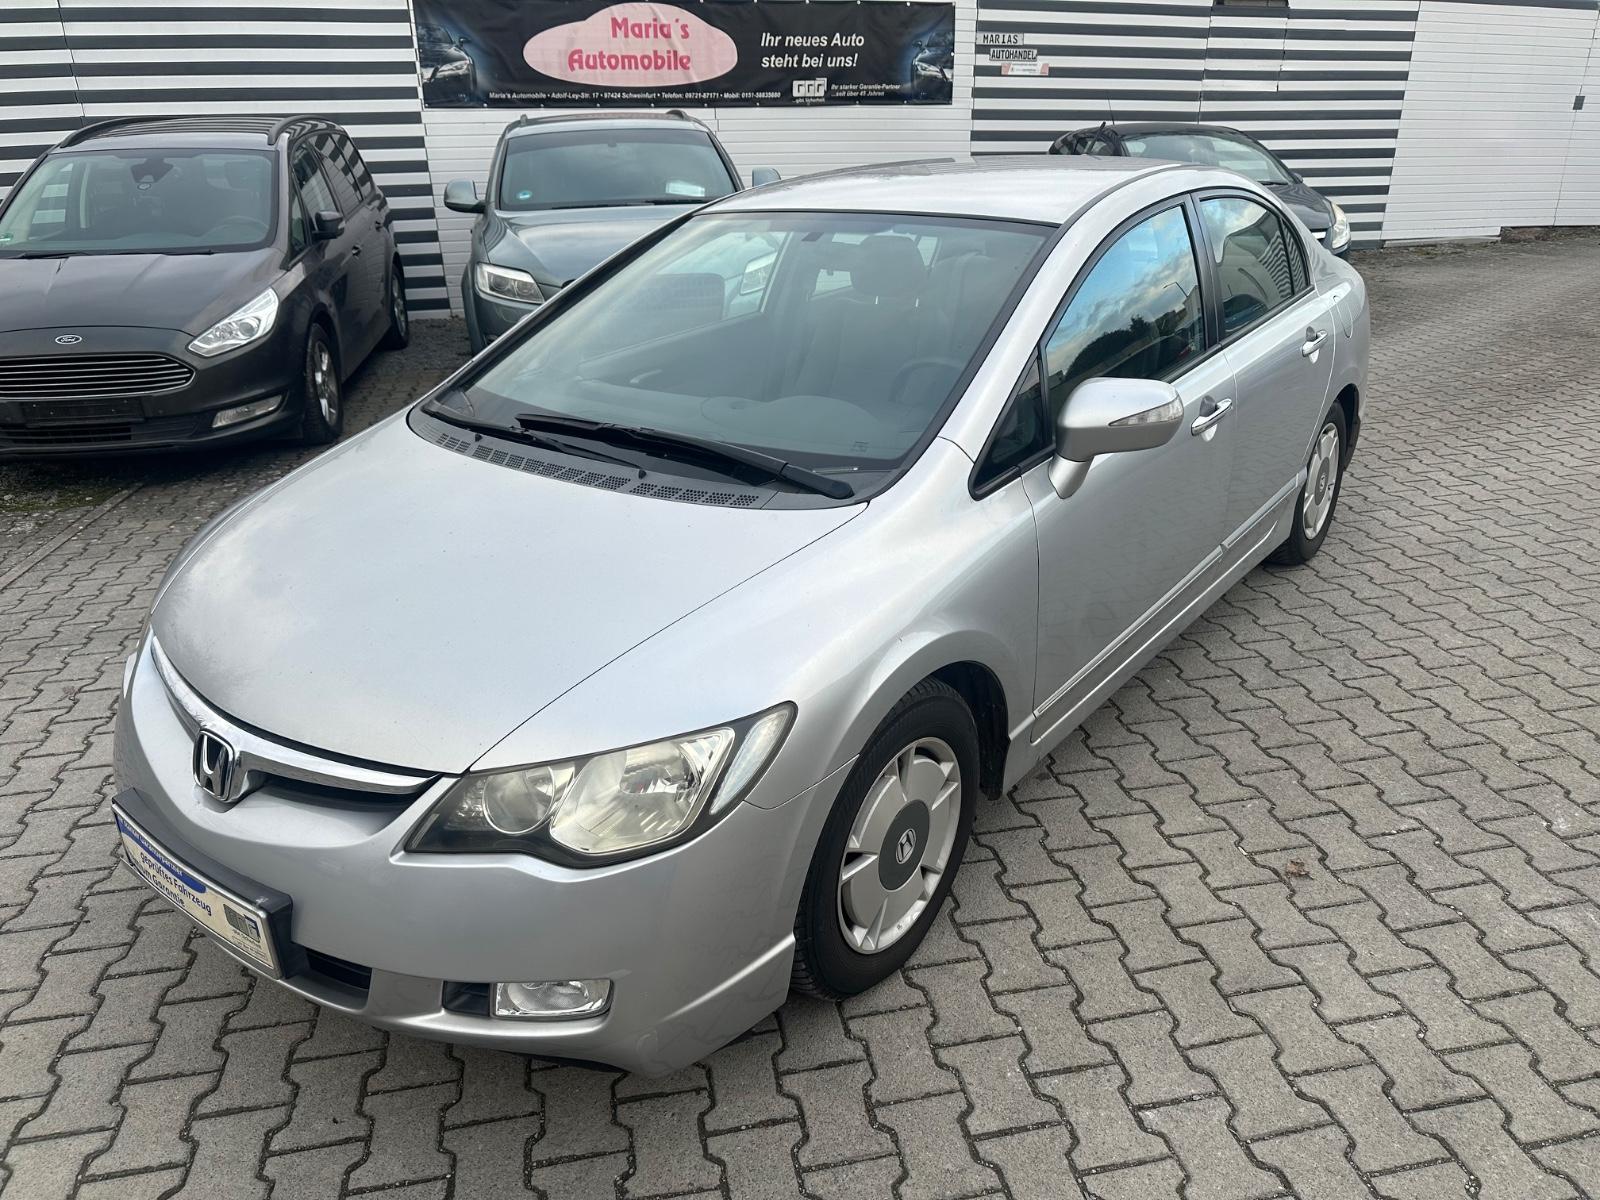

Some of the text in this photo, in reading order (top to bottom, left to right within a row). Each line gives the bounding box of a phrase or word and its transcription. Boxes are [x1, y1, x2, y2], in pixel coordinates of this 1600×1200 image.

[760, 32, 865, 46] Ihr neues Auto
[982, 33, 1019, 44] MARIAS
[568, 49, 691, 72] Automobile
[761, 53, 858, 67] steht bei uns!
[991, 49, 1036, 60] AUTOHANDEL
[140, 852, 173, 886] geprüftes
[173, 879, 212, 917] Fahrzeug
[151, 874, 186, 908] Garantie
